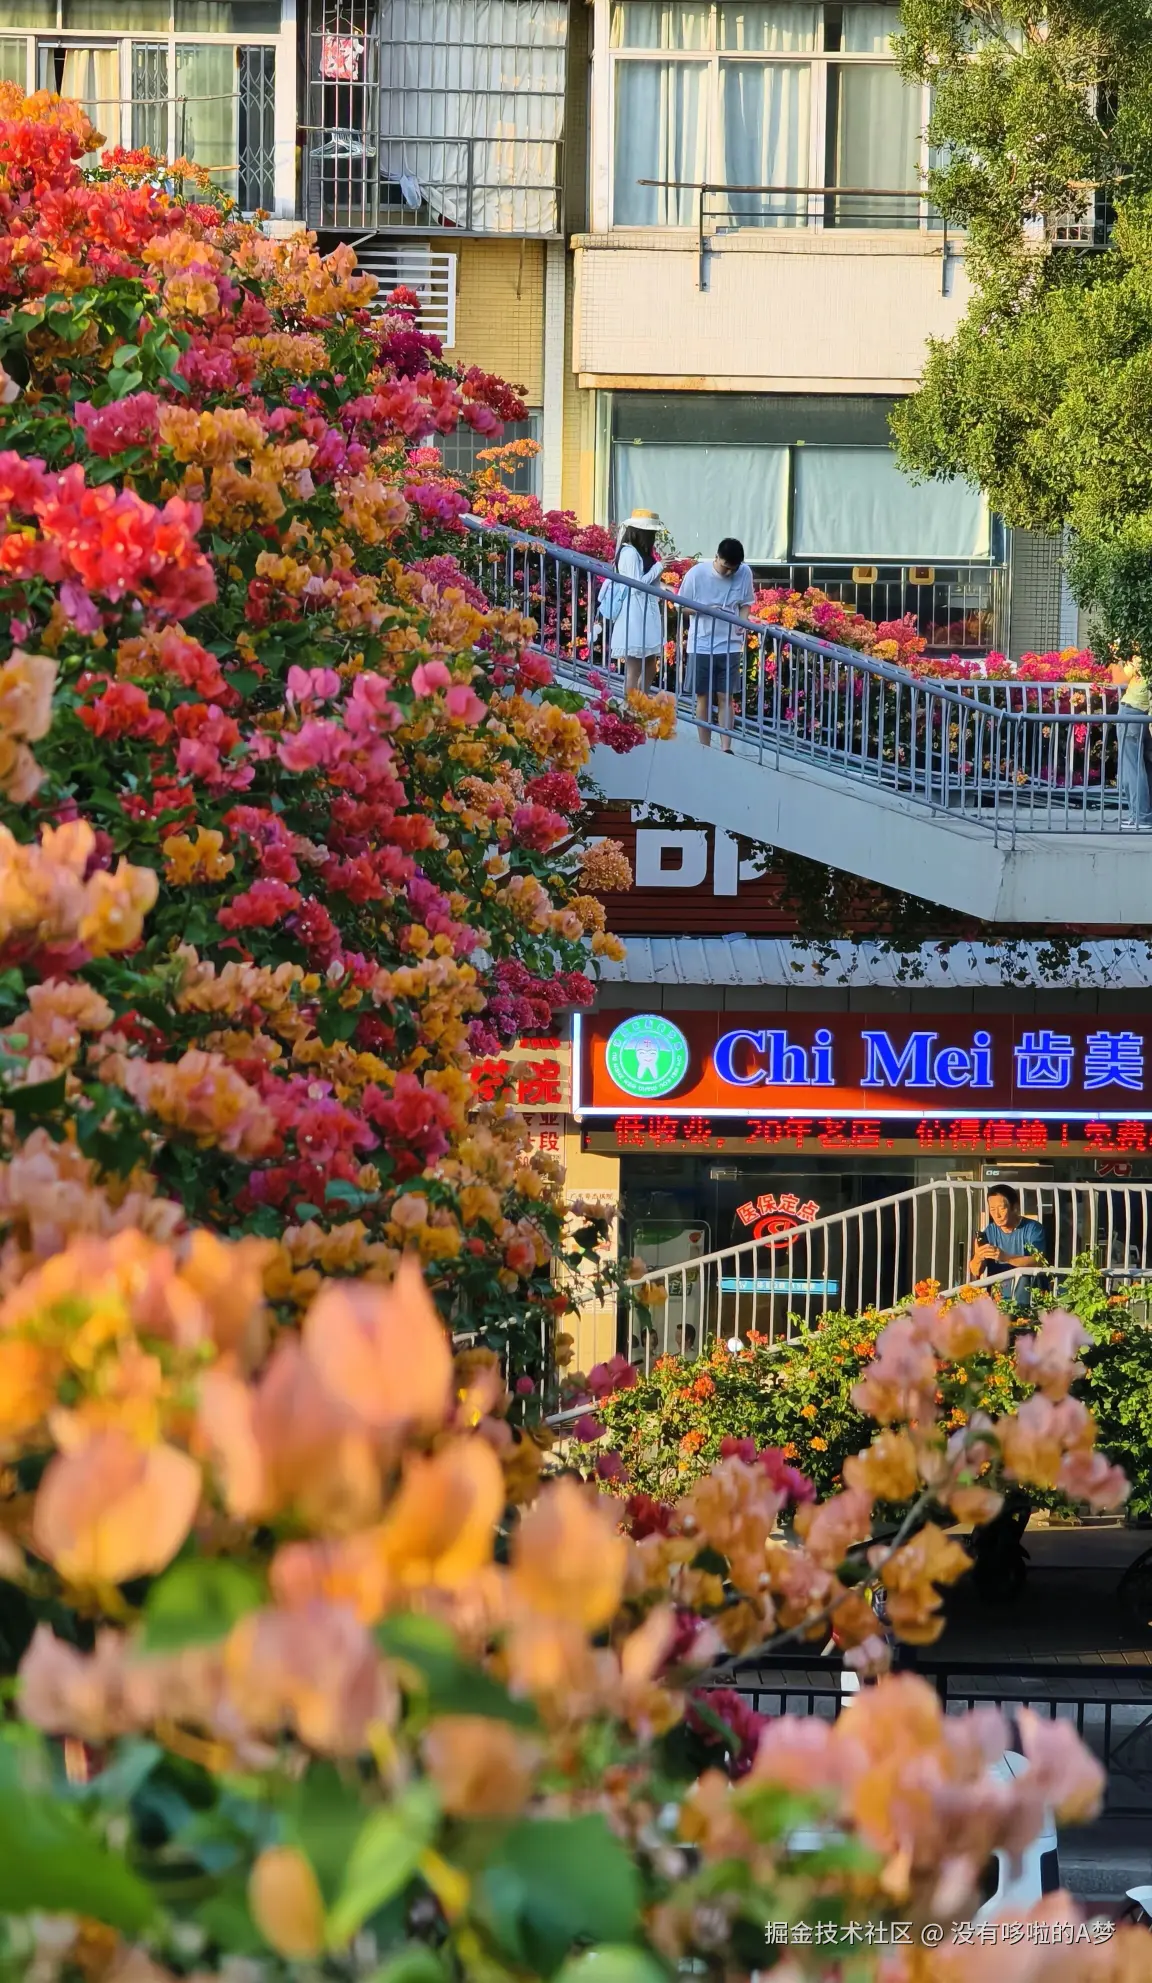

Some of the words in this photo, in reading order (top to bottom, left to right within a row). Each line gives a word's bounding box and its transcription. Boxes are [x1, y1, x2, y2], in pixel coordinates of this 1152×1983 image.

[713, 1029, 835, 1087] Chi
[860, 1031, 994, 1088] Mei
[1014, 1030, 1145, 1091] 齿美
[736, 1193, 820, 1225] 医保定点
